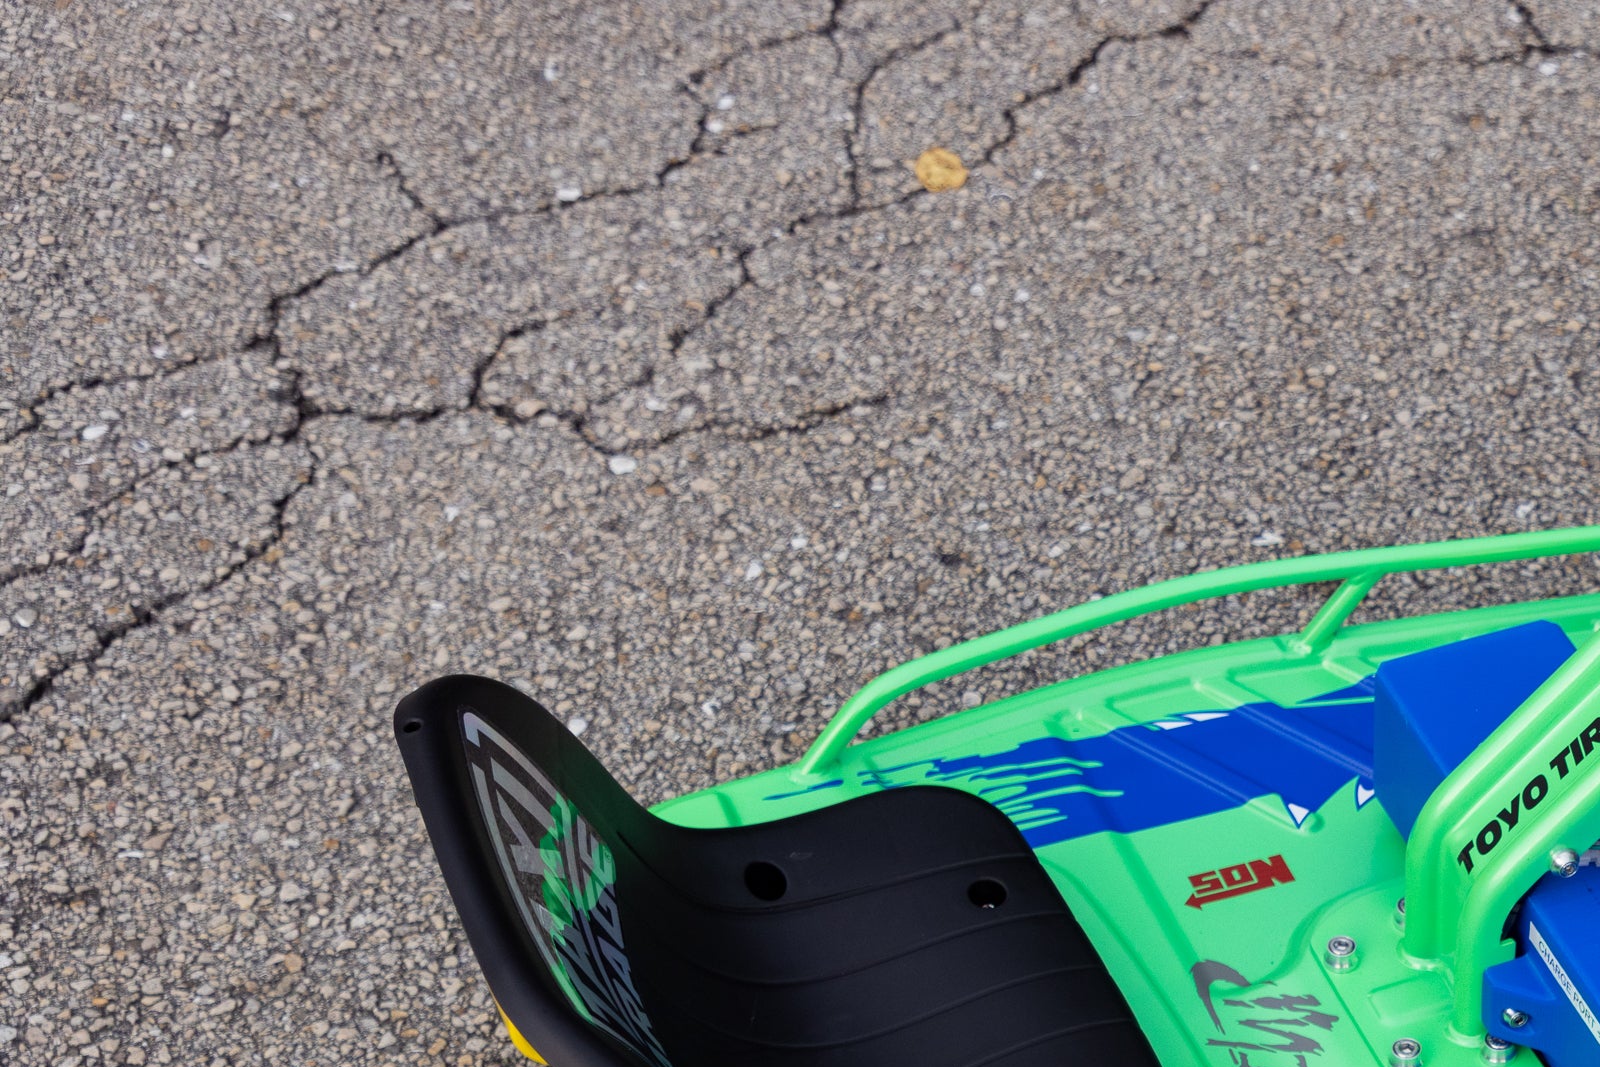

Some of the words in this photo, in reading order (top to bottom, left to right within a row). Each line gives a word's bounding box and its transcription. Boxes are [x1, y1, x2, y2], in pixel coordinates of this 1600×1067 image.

[1457, 774, 1549, 875] TOYO
[1538, 940, 1572, 998] CHARGE
[1573, 991, 1597, 1029] PORT
